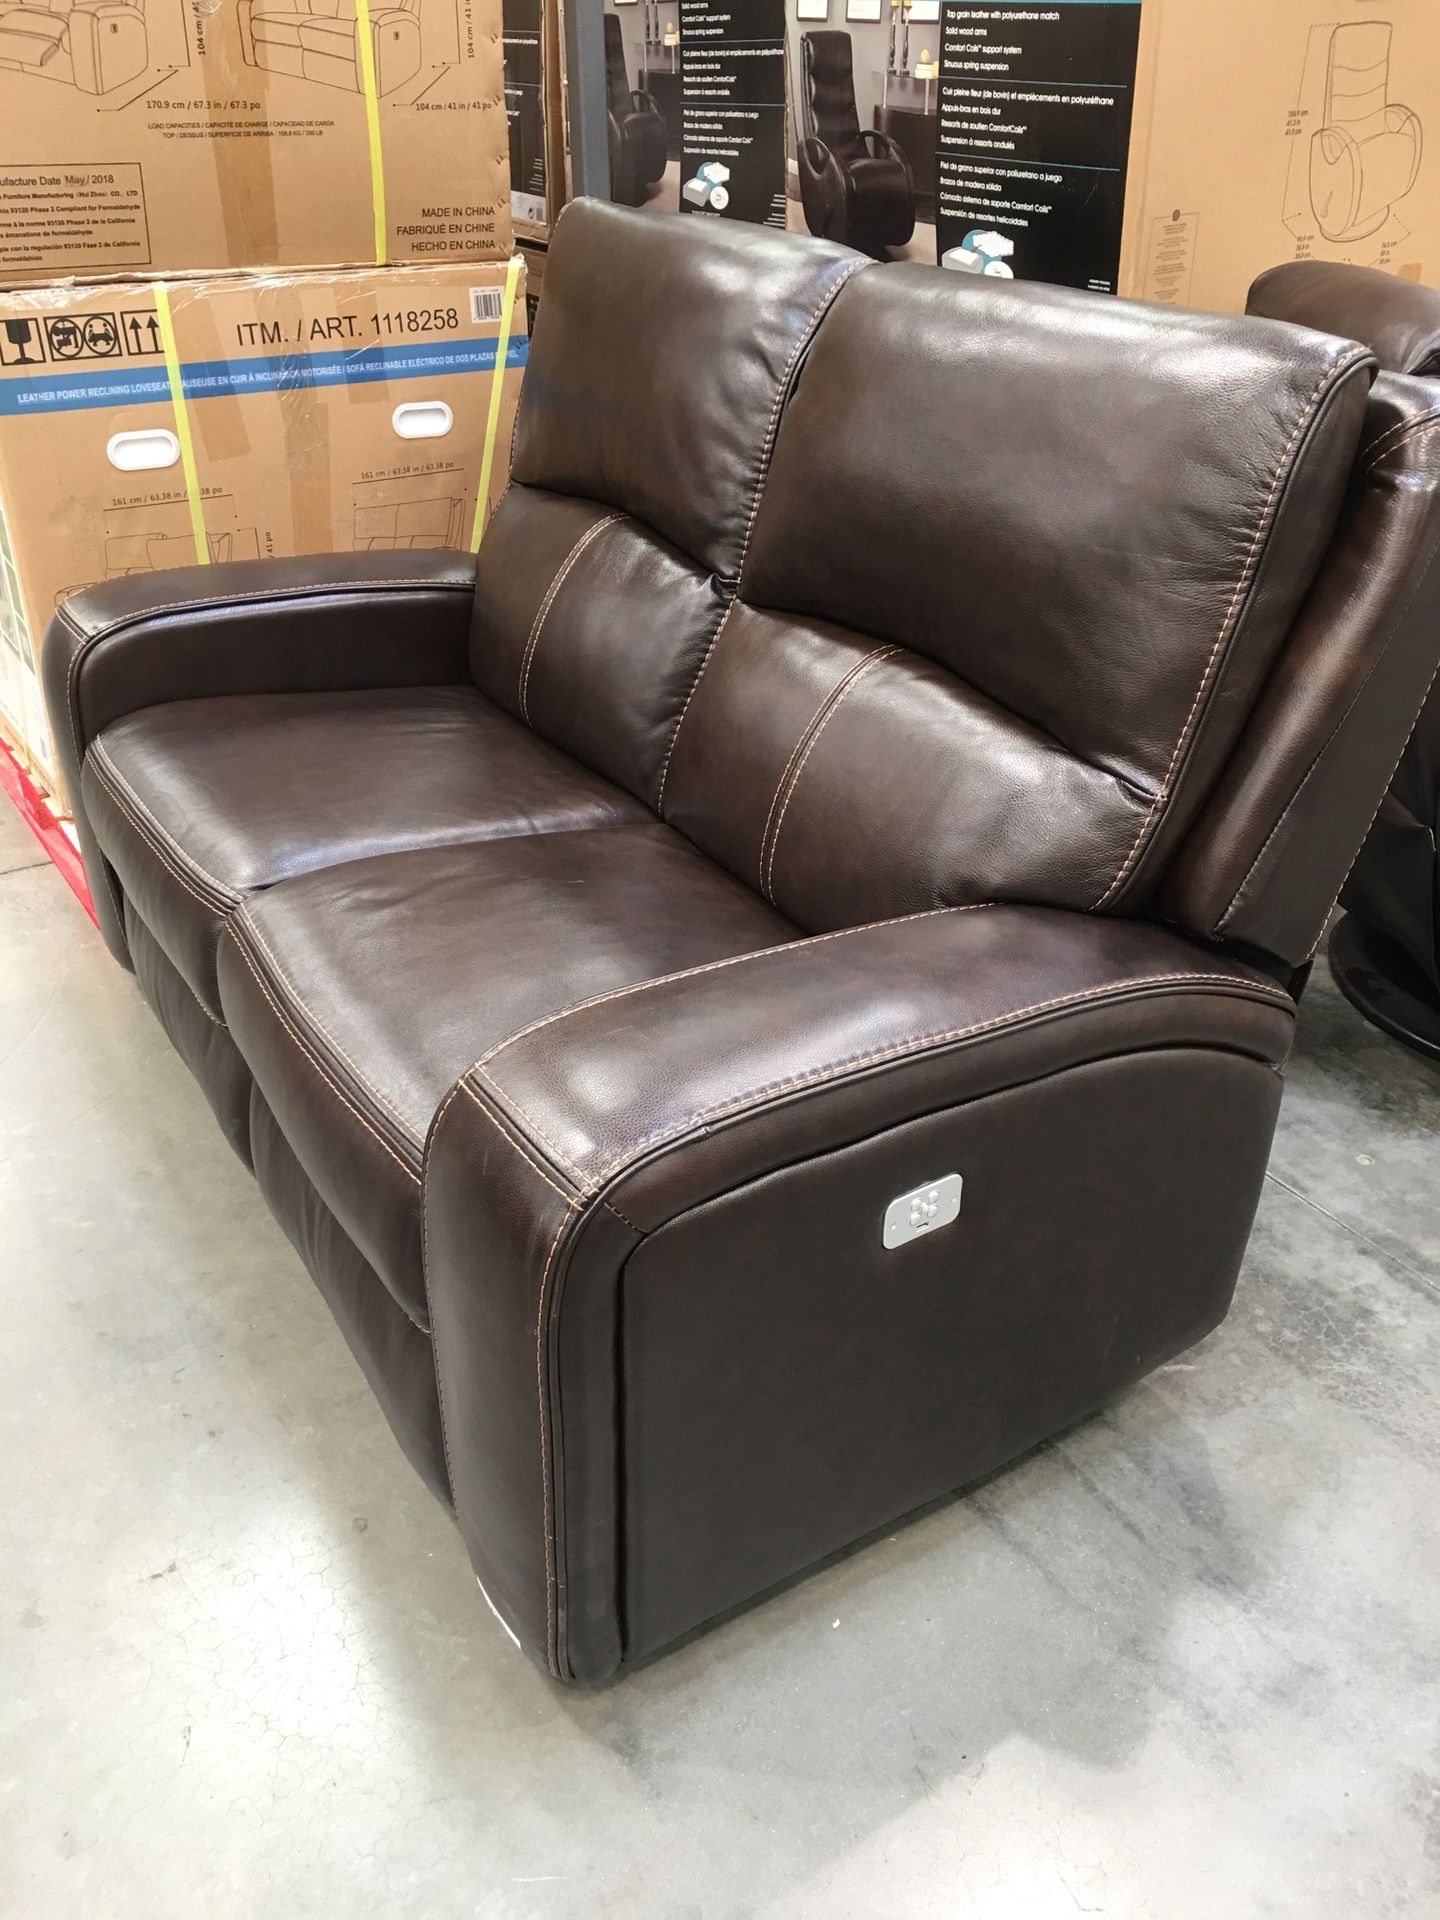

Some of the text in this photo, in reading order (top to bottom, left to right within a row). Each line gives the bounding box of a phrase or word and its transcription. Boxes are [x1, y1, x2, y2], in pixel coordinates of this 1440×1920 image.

[464, 8, 472, 18] 41
[947, 10, 1060, 20] Top grain leather with polyurethane match
[196, 20, 204, 35] cm
[466, 27, 473, 40] cm
[946, 27, 958, 35] Solid
[959, 27, 973, 35] wood
[197, 37, 206, 56] 104
[945, 43, 965, 52] Comfort
[982, 45, 1002, 54] support
[1003, 46, 1022, 55] system
[944, 60, 1009, 71] Sinuous spring suspension
[942, 87, 953, 96] Cuir
[954, 88, 969, 97] pleine
[983, 90, 992, 99] (de
[993, 90, 1010, 100] bovin)
[1071, 95, 1113, 105] polyuréthane
[147, 101, 169, 109] 170.9
[194, 101, 211, 109] 67.3
[214, 101, 221, 109] in
[230, 101, 248, 109] 67.3
[250, 102, 260, 110] po
[416, 103, 429, 111] 104
[448, 102, 457, 110] 41
[458, 102, 466, 110] in
[942, 103, 971, 113] Appuis-bras
[980, 106, 991, 114] bois
[992, 107, 1001, 115] dur
[941, 119, 960, 128] Ressorts
[970, 122, 988, 130] soutien
[941, 135, 968, 145] Suspension
[974, 139, 992, 147] ressorts
[994, 140, 1015, 149] ondulés
[940, 161, 949, 170] Piel
[958, 164, 973, 173] grano
[974, 165, 995, 175] superior
[995, 168, 1006, 176] con
[1007, 168, 1038, 180] poliuretano
[1045, 173, 1062, 183] juego
[39, 176, 61, 185] Date
[65, 175, 84, 185] May
[92, 175, 114, 184] 2018
[940, 177, 1002, 191] Brazos de madera sólida
[940, 192, 961, 202] Cómodo
[963, 195, 981, 204] sistema
[983, 198, 990, 206] de
[991, 199, 1010, 208] soporte
[1012, 201, 1033, 211] Comfort
[422, 206, 495, 218] MADE IN CHINA
[940, 207, 1028, 227] Suspensión de resortes helicoidales
[397, 223, 495, 236] FABRIQUÉ EN CHINE
[412, 240, 495, 251] HECHO EN CHINA
[236, 308, 459, 346] ITM. / ART. 1118258
[18, 391, 55, 403] LEATHER
[57, 389, 87, 400] POWER
[88, 385, 129, 398] RECLINING
[131, 382, 169, 394] LOVESEAT
[182, 377, 217, 388] AUSEUSE
[219, 376, 229, 385] EN
[231, 375, 247, 384] CUIR
[366, 359, 407, 372] RECLINABLE
[408, 355, 444, 369] ELÉCTRICO
[445, 355, 454, 365] DE
[455, 354, 469, 364] DOS
[470, 352, 494, 362] PLAZAS
[393, 466, 410, 475] 63.38
[426, 462, 443, 471] 63.38
[112, 498, 127, 506] 161
[150, 492, 171, 501] 63.38
[265, 532, 273, 554] 41 po
